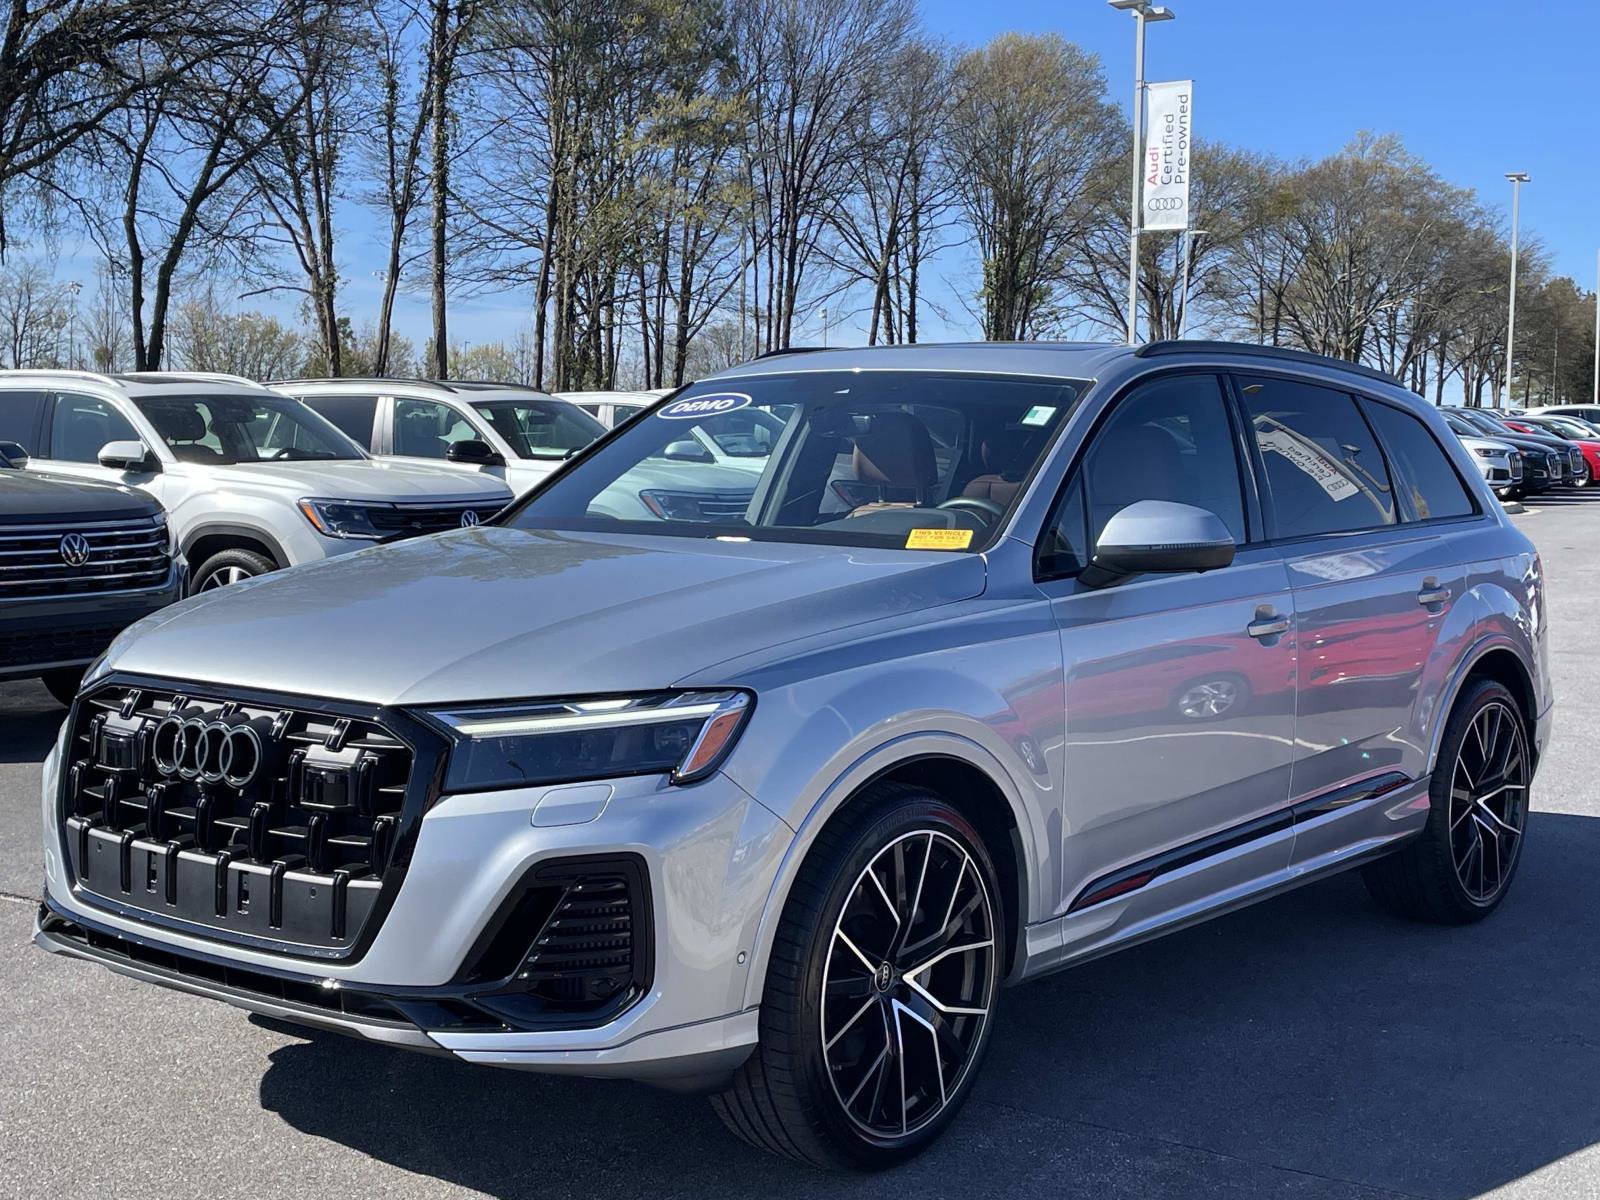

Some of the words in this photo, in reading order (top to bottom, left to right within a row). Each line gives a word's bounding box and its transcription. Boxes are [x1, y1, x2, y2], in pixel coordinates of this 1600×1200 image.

[1147, 147, 1159, 186] Audi
[1161, 114, 1174, 185] Certified
[1174, 94, 1189, 184] Pre-owned
[669, 399, 734, 413] DEMO
